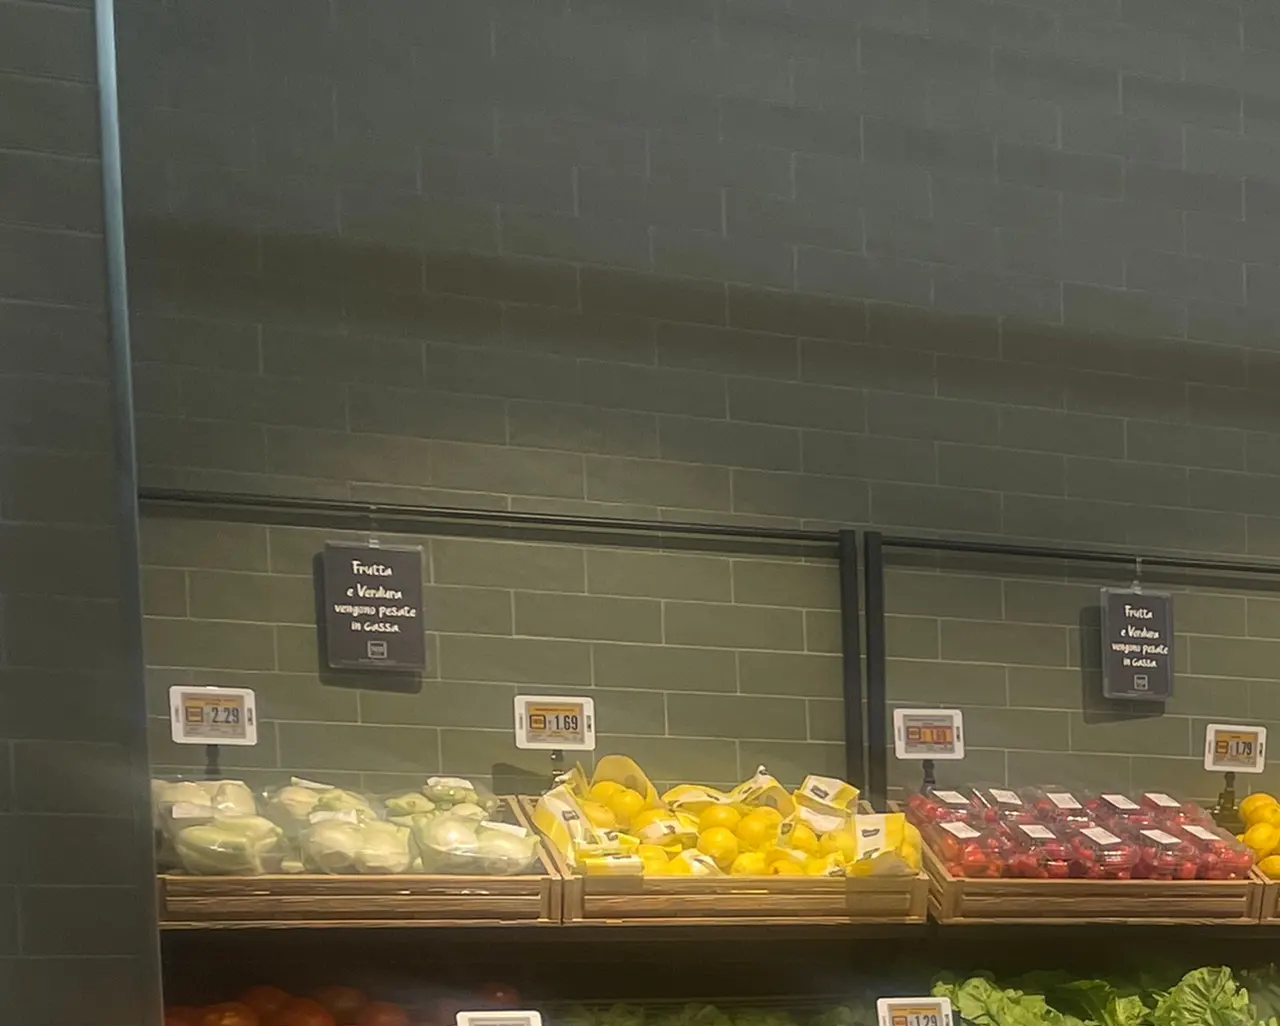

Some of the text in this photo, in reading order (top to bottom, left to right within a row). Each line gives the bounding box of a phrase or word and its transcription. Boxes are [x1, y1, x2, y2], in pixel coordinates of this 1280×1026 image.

[351, 560, 392, 576] Frutta
[346, 583, 402, 599] e Verdura
[334, 604, 416, 618] vengono pesate
[1124, 605, 1153, 618] Frutta
[351, 621, 361, 631] in
[211, 708, 240, 724] 2.29
[554, 715, 578, 730] 1.69
[1235, 741, 1252, 756] 1.79
